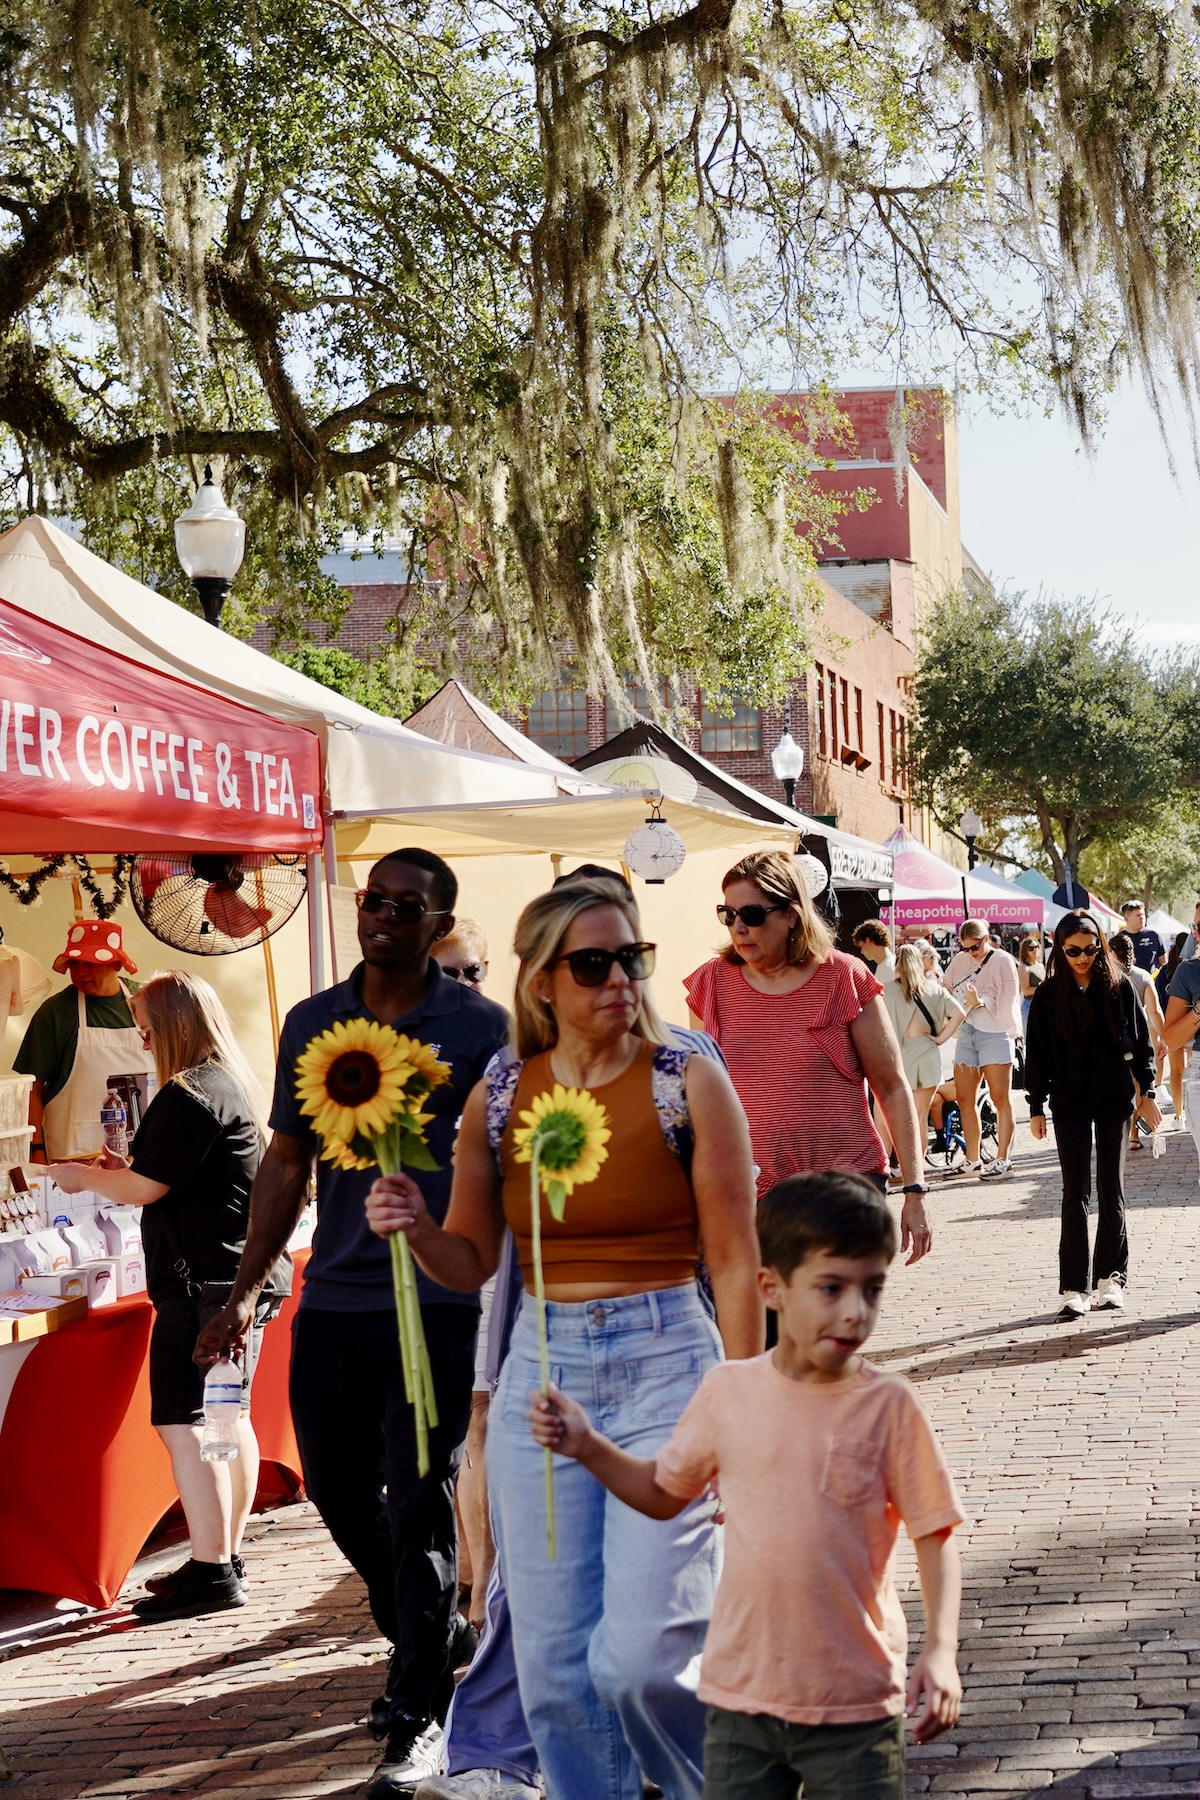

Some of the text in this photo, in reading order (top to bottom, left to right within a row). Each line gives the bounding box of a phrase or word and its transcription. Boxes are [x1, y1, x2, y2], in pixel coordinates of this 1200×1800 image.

[76, 715, 209, 804] COFFEE
[215, 741, 241, 810] &
[245, 750, 298, 818] TEA
